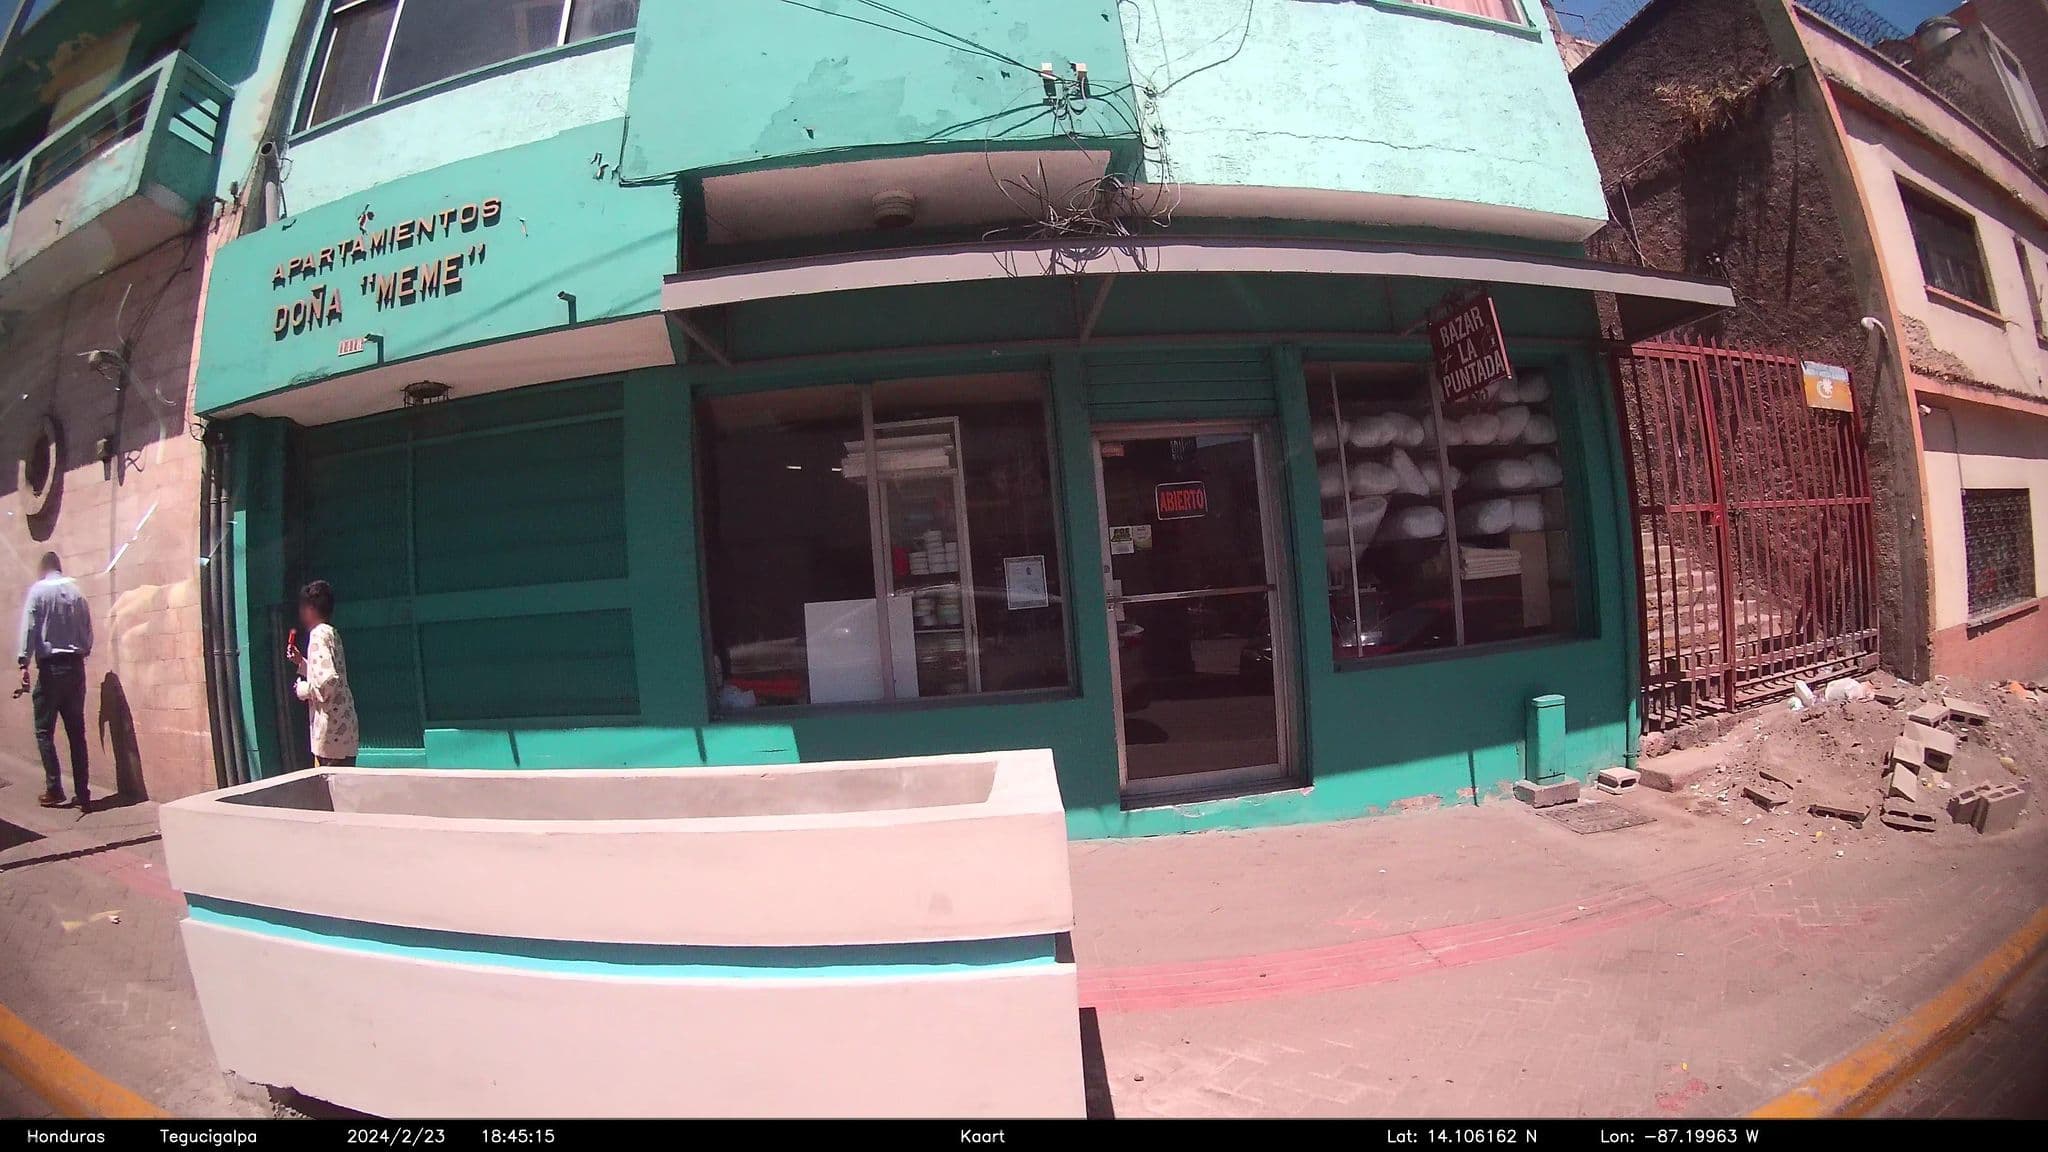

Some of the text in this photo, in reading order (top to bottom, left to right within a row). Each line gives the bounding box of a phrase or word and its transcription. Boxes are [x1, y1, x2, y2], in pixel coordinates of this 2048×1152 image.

[272, 198, 501, 288] APARTAMIENTOS
[274, 285, 342, 336] DOÑA
[1440, 306, 1484, 348] BAZAR
[1458, 338, 1478, 364] LA
[1443, 350, 1505, 398] PUNTADA
[1160, 488, 1204, 512] ABIERTO
